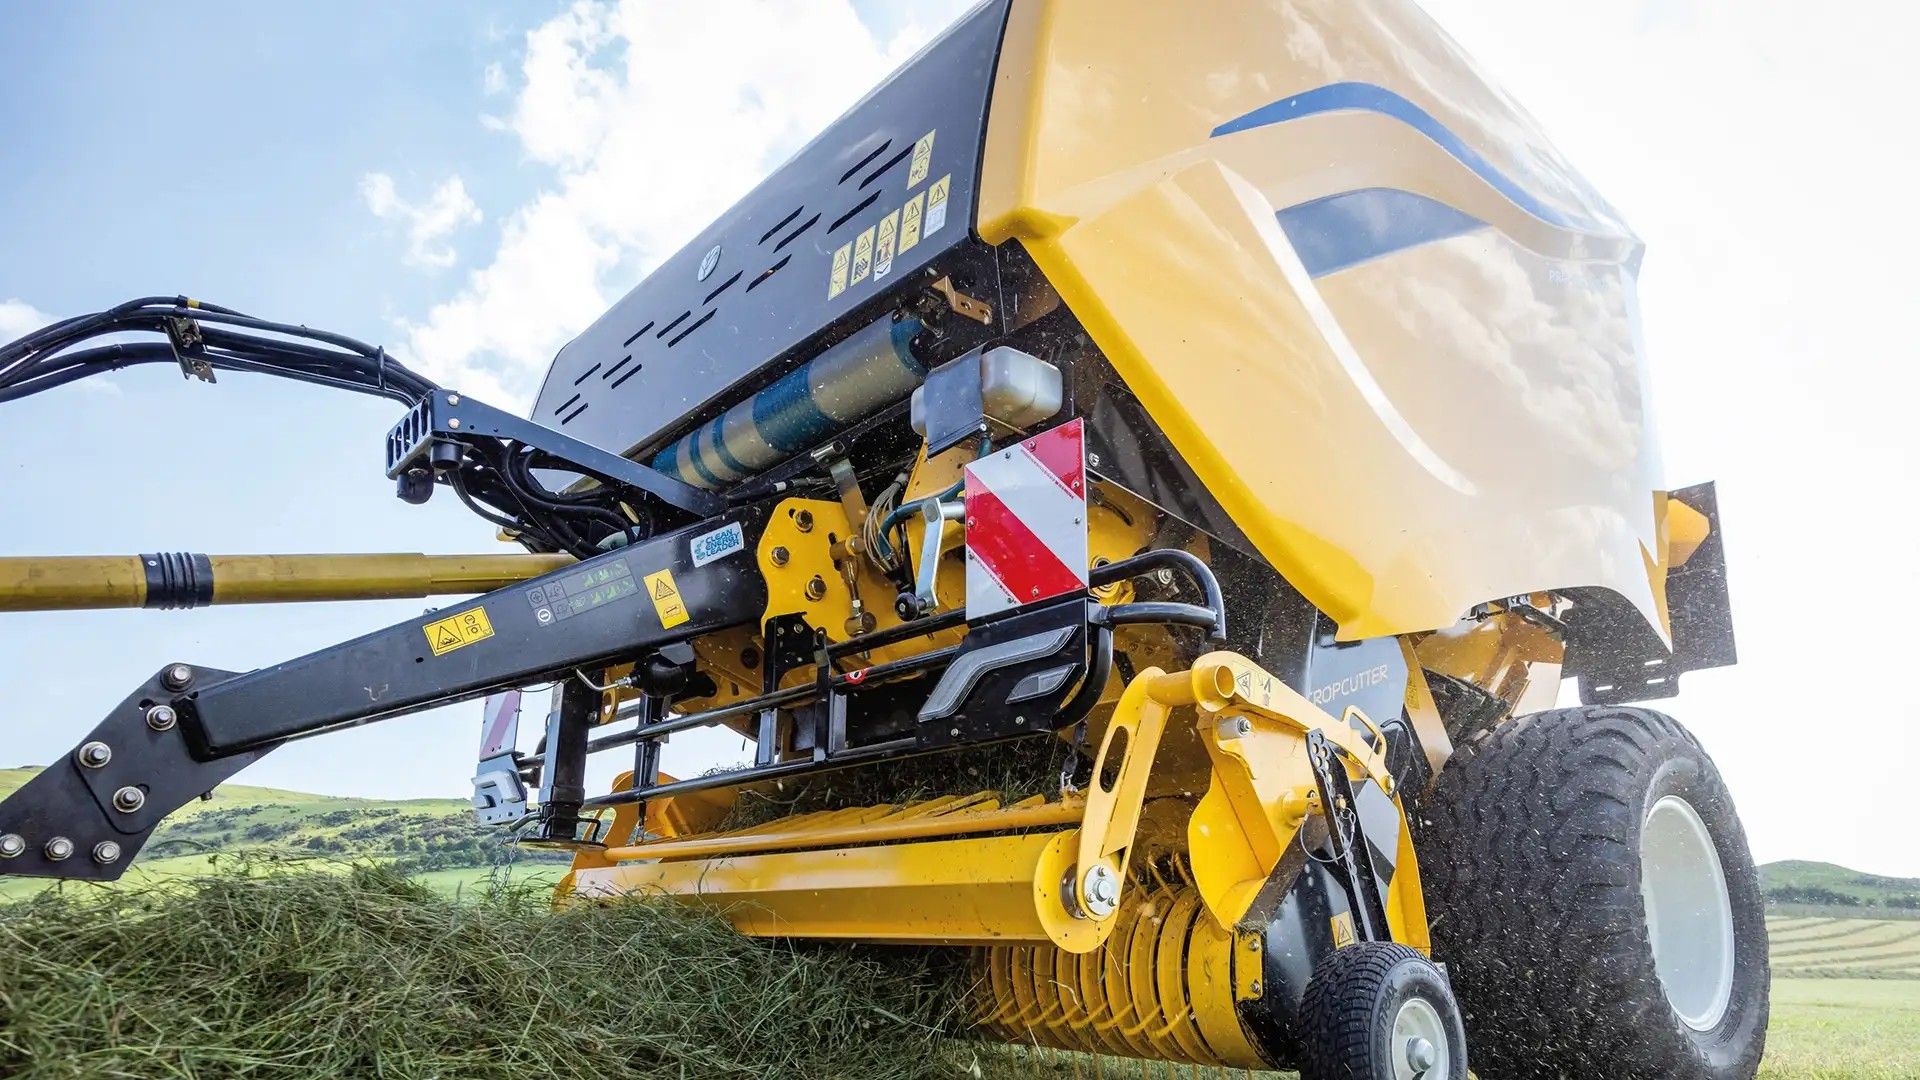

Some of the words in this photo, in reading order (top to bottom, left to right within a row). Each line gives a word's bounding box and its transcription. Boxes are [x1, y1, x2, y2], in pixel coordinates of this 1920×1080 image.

[705, 528, 733, 543] CLEAN
[705, 531, 740, 551] ENERGY
[706, 540, 740, 557] LEADER
[1307, 664, 1389, 705] ROPCUTTER
